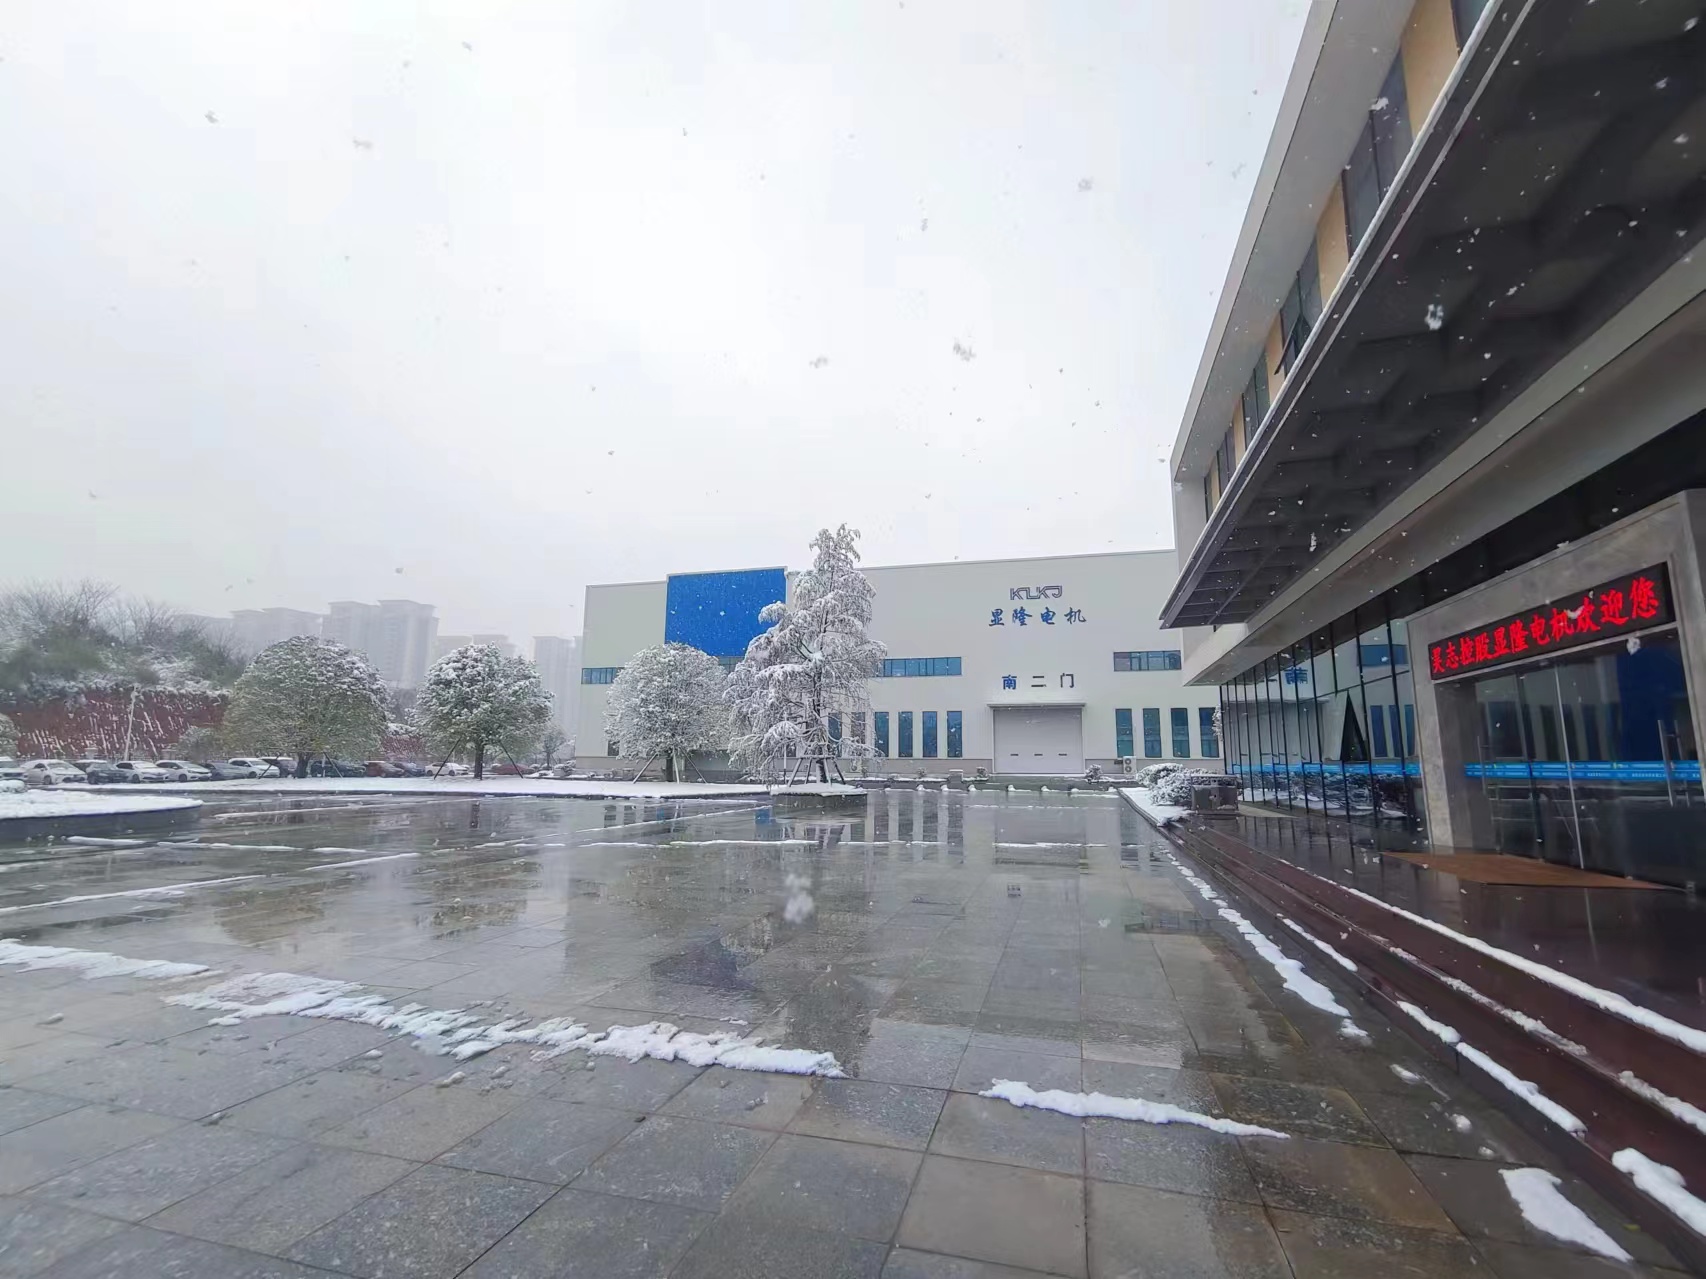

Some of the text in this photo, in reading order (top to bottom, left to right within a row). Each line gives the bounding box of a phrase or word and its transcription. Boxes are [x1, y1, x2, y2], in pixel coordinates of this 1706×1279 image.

[1010, 585, 1063, 600] KLKJ
[988, 606, 1087, 627] 显隆电机
[1431, 577, 1660, 673] 昊志控股显隆电机欢迎您
[1001, 673, 1075, 690] 南二门
